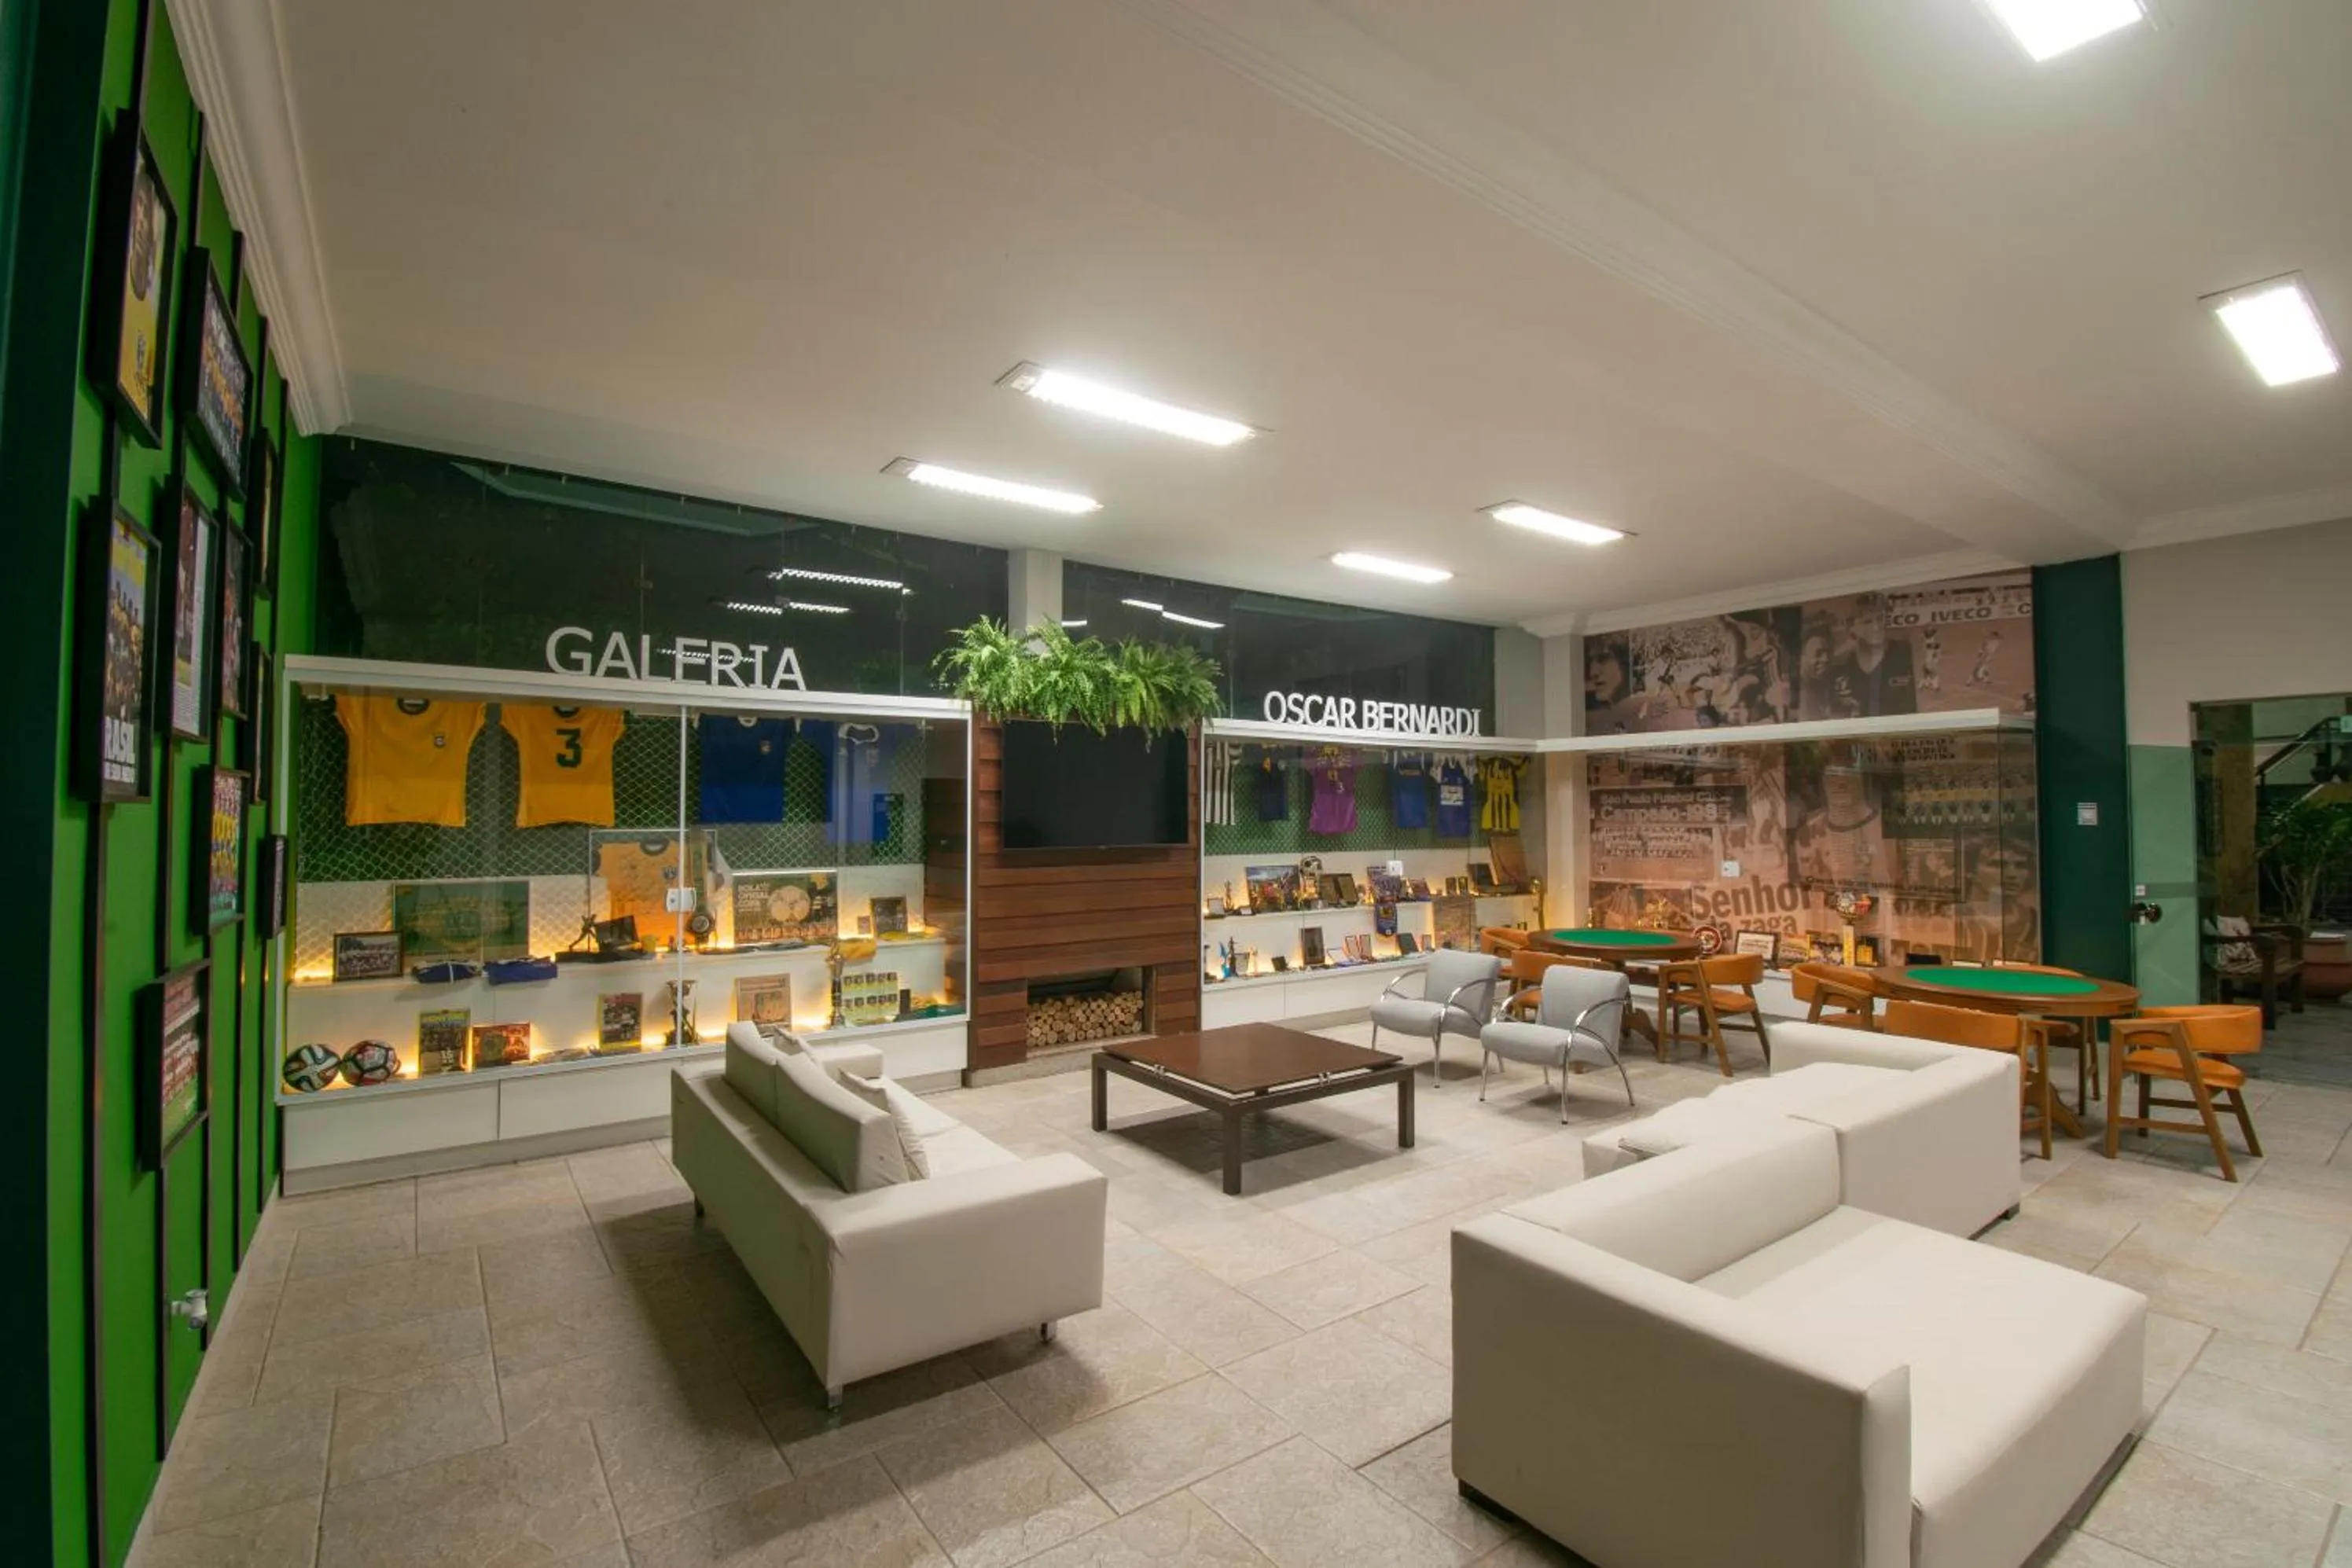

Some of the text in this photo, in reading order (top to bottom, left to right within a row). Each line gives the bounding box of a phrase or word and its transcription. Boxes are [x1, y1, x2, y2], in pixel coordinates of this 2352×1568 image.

[1931, 607, 1992, 622] IVECO
[546, 626, 807, 692] GALERIA
[1263, 691, 1482, 736] OSCAR BERNARDI
[556, 728, 583, 769] 3
[1693, 874, 1810, 920] Senhor
